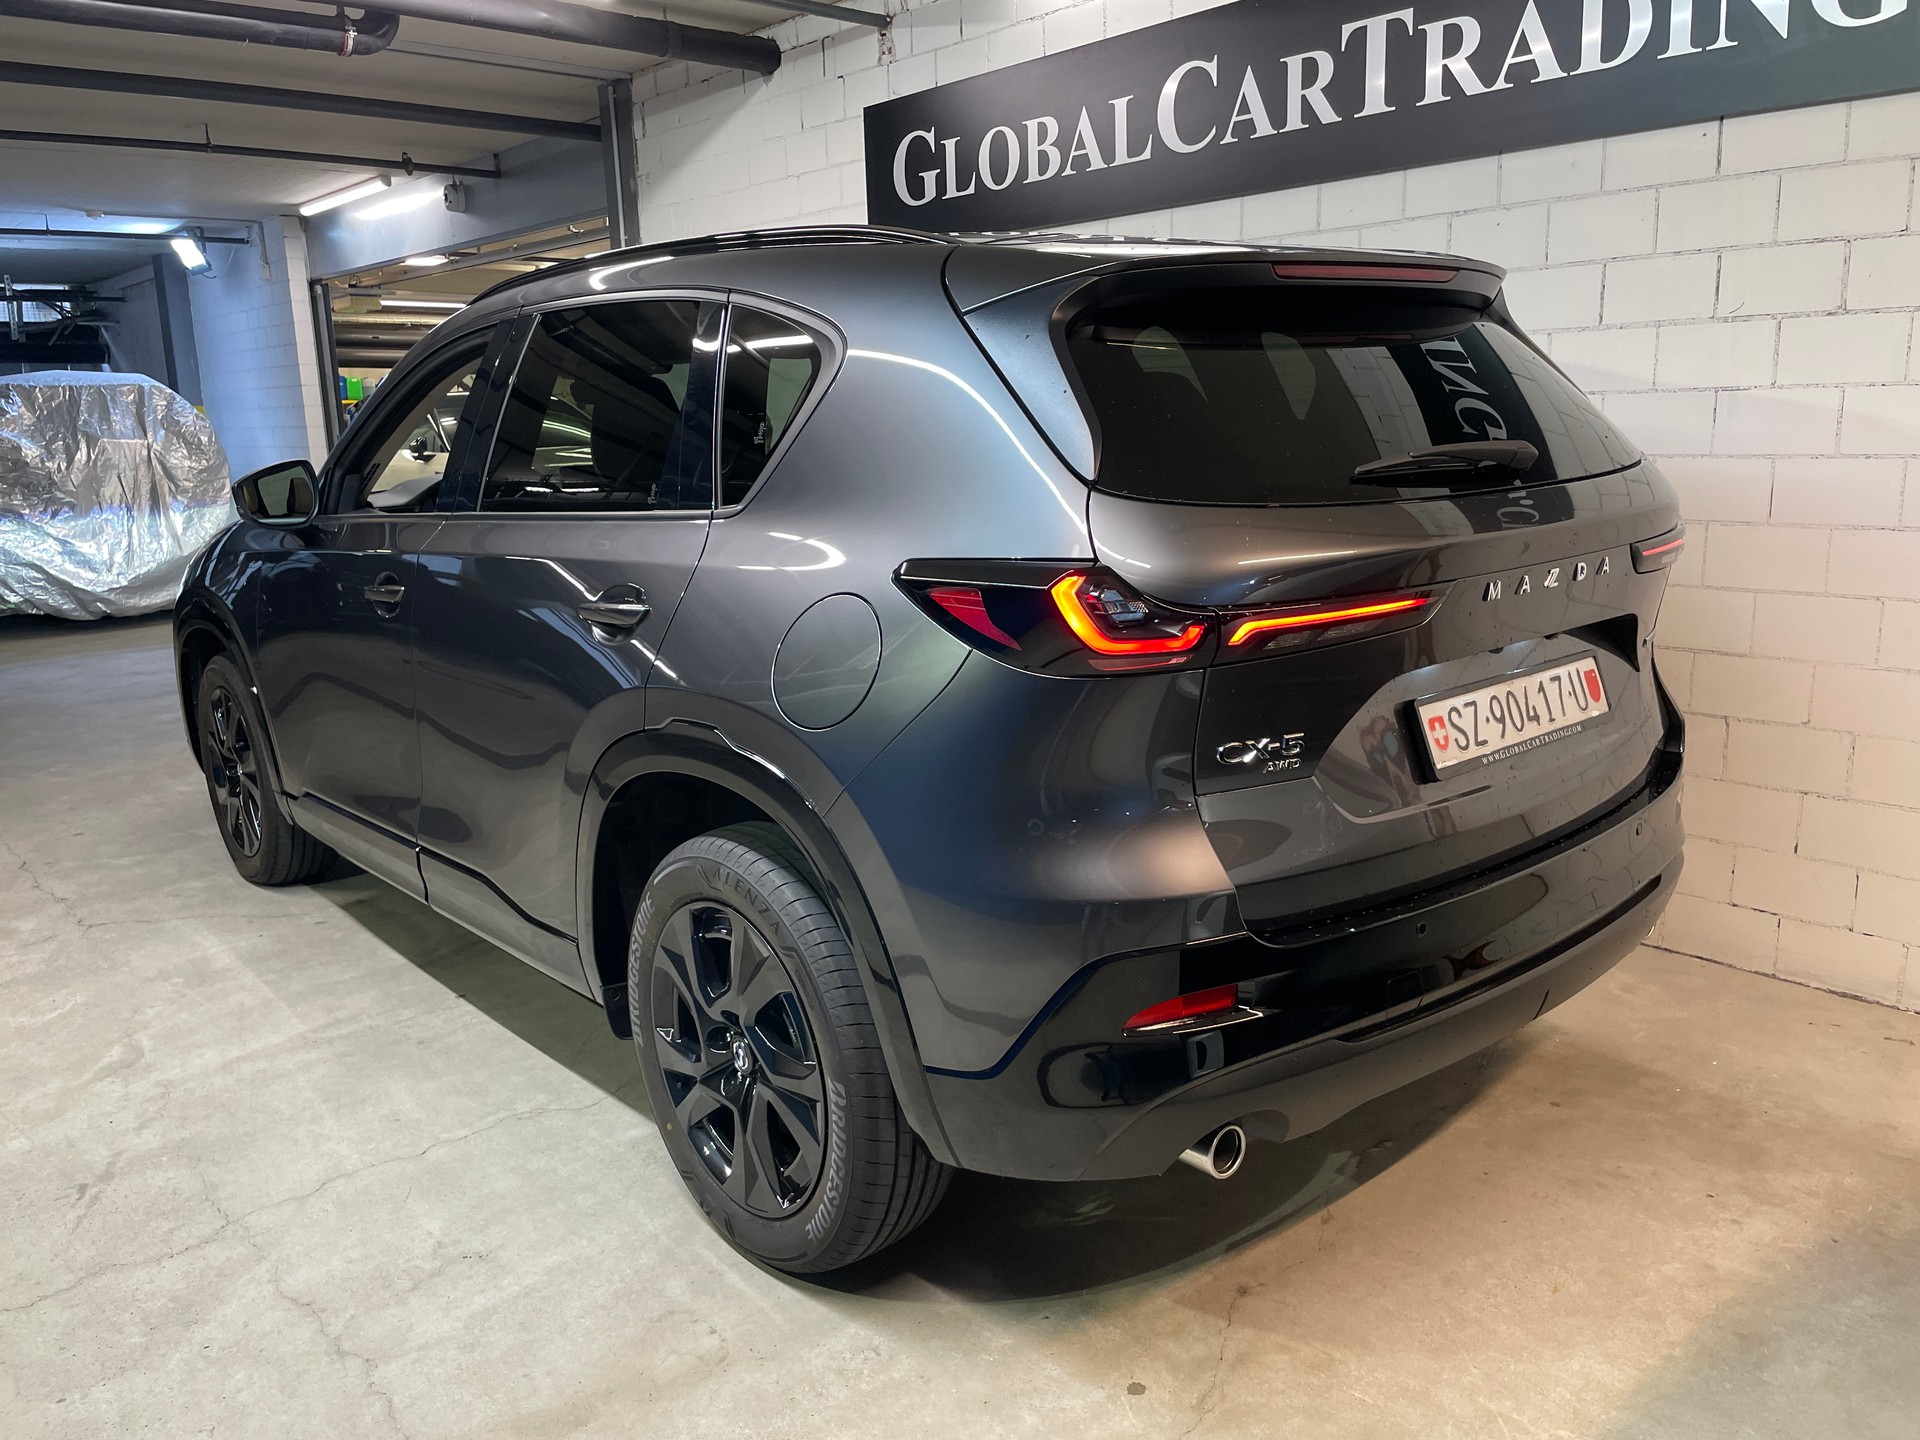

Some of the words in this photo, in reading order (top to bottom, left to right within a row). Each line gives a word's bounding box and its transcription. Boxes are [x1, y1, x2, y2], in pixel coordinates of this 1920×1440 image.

[893, 0, 1908, 207] GLOBALCARTRADI
[1482, 556, 1610, 602] MAZDA
[1216, 732, 1305, 765] CX-5
[1262, 758, 1302, 774] AWD
[713, 868, 781, 937] ALENZA
[627, 891, 656, 1048] BRIDGESTONE
[804, 1075, 847, 1244] BRIDGESTONE
